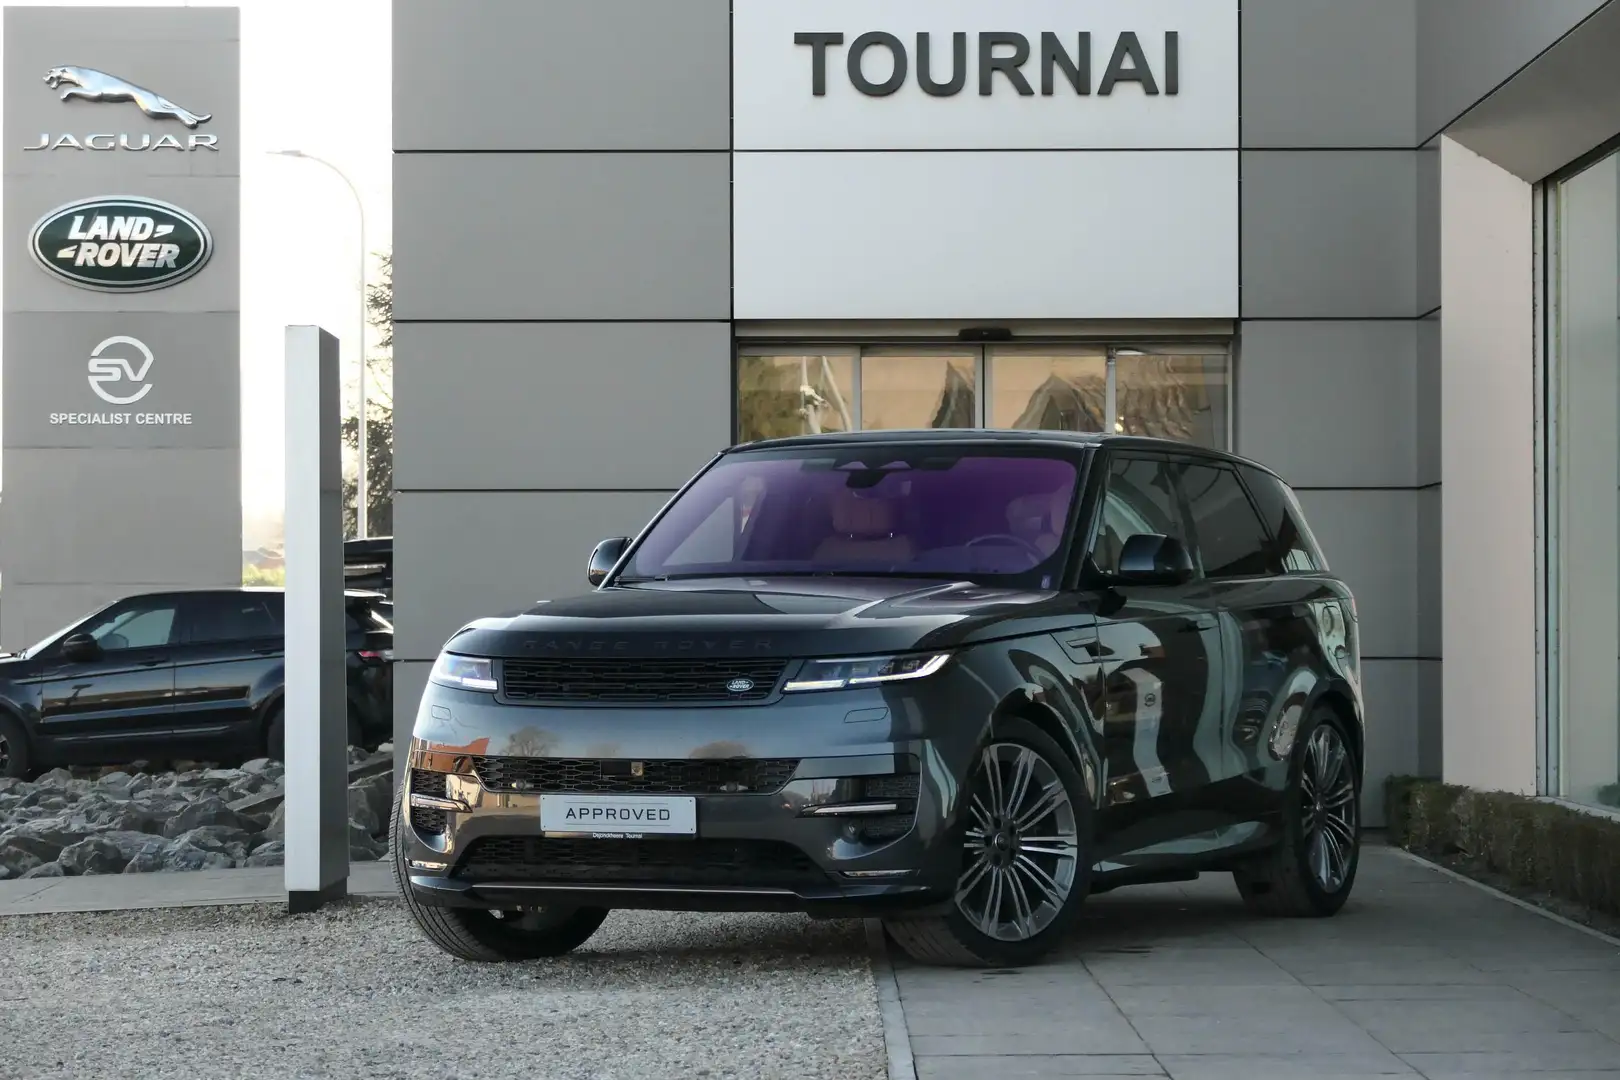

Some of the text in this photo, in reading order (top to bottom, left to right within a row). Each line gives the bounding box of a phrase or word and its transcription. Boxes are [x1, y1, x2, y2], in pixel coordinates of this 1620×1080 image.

[794, 31, 1179, 97] TOURNAI
[23, 133, 219, 151] JAGUAR
[68, 215, 154, 241] LAND
[74, 242, 181, 268] ROVER
[49, 413, 192, 425] SPECIALIST CENTRE
[565, 807, 671, 821] APPROVED
